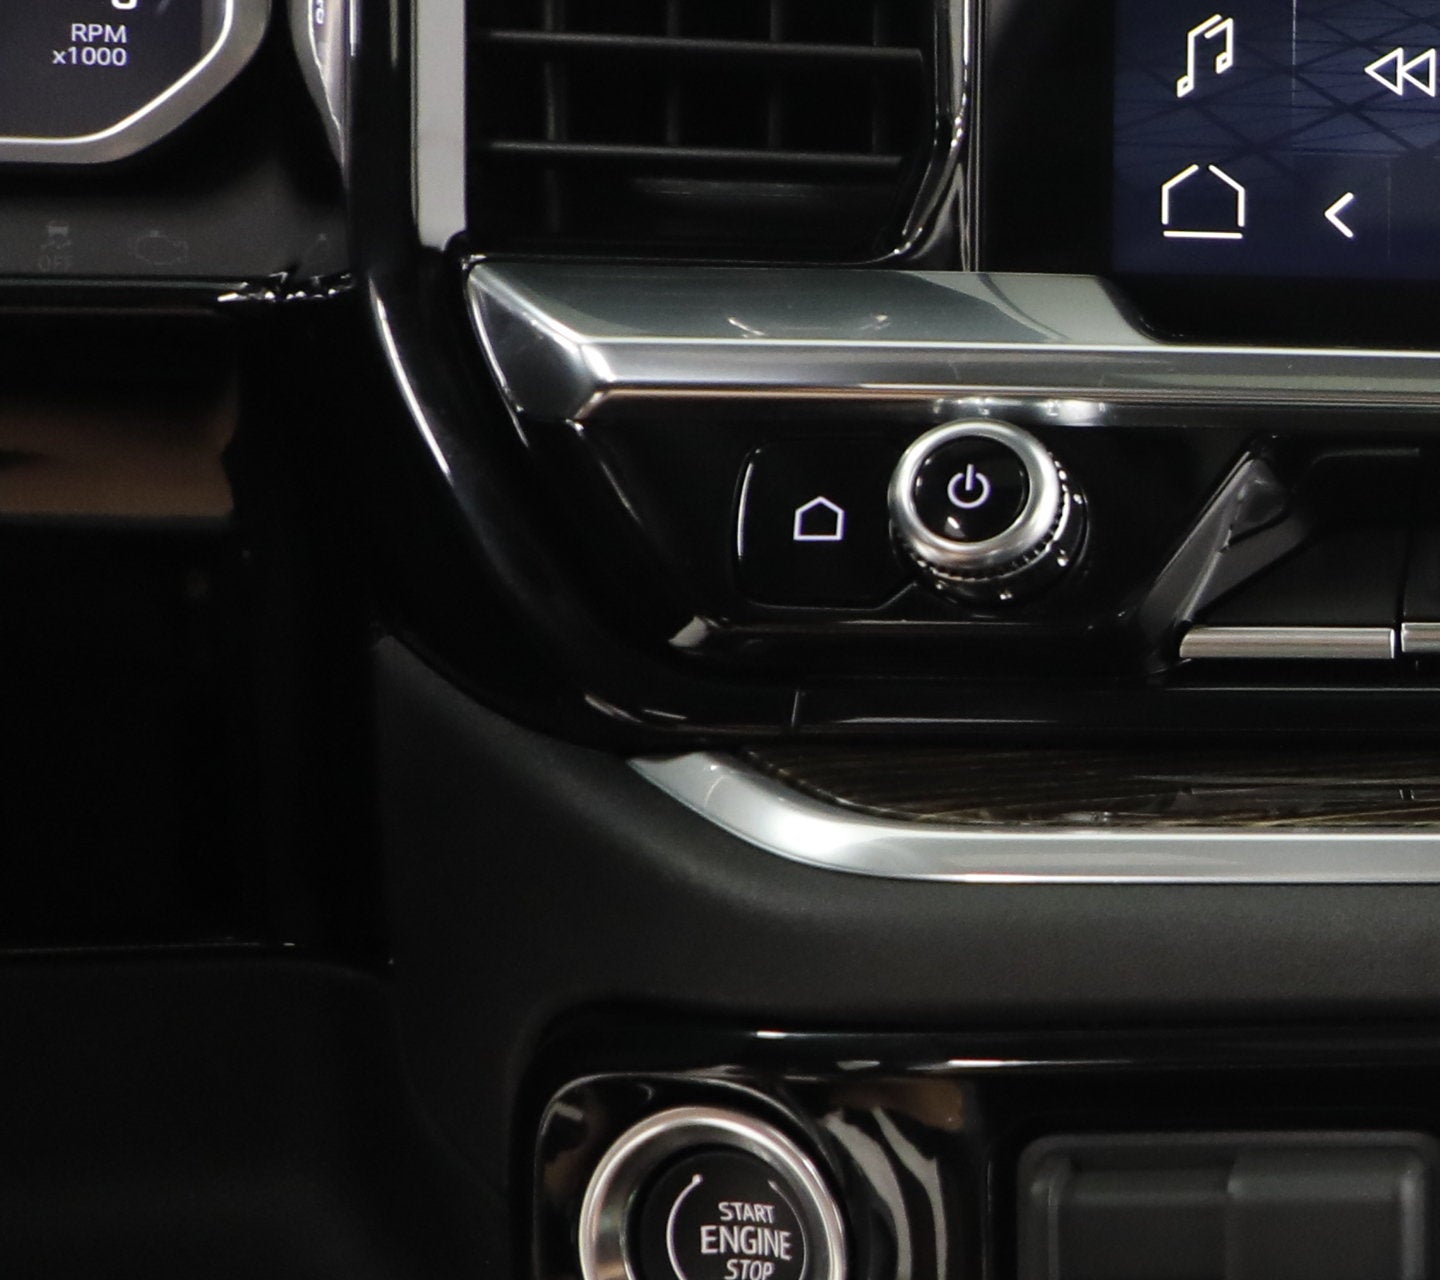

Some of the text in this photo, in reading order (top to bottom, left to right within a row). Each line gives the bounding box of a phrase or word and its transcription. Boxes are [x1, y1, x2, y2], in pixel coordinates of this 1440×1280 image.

[72, 24, 127, 43] RPM
[53, 47, 127, 66] x1000
[719, 1202, 773, 1223] START
[701, 1225, 792, 1261] ENGINE
